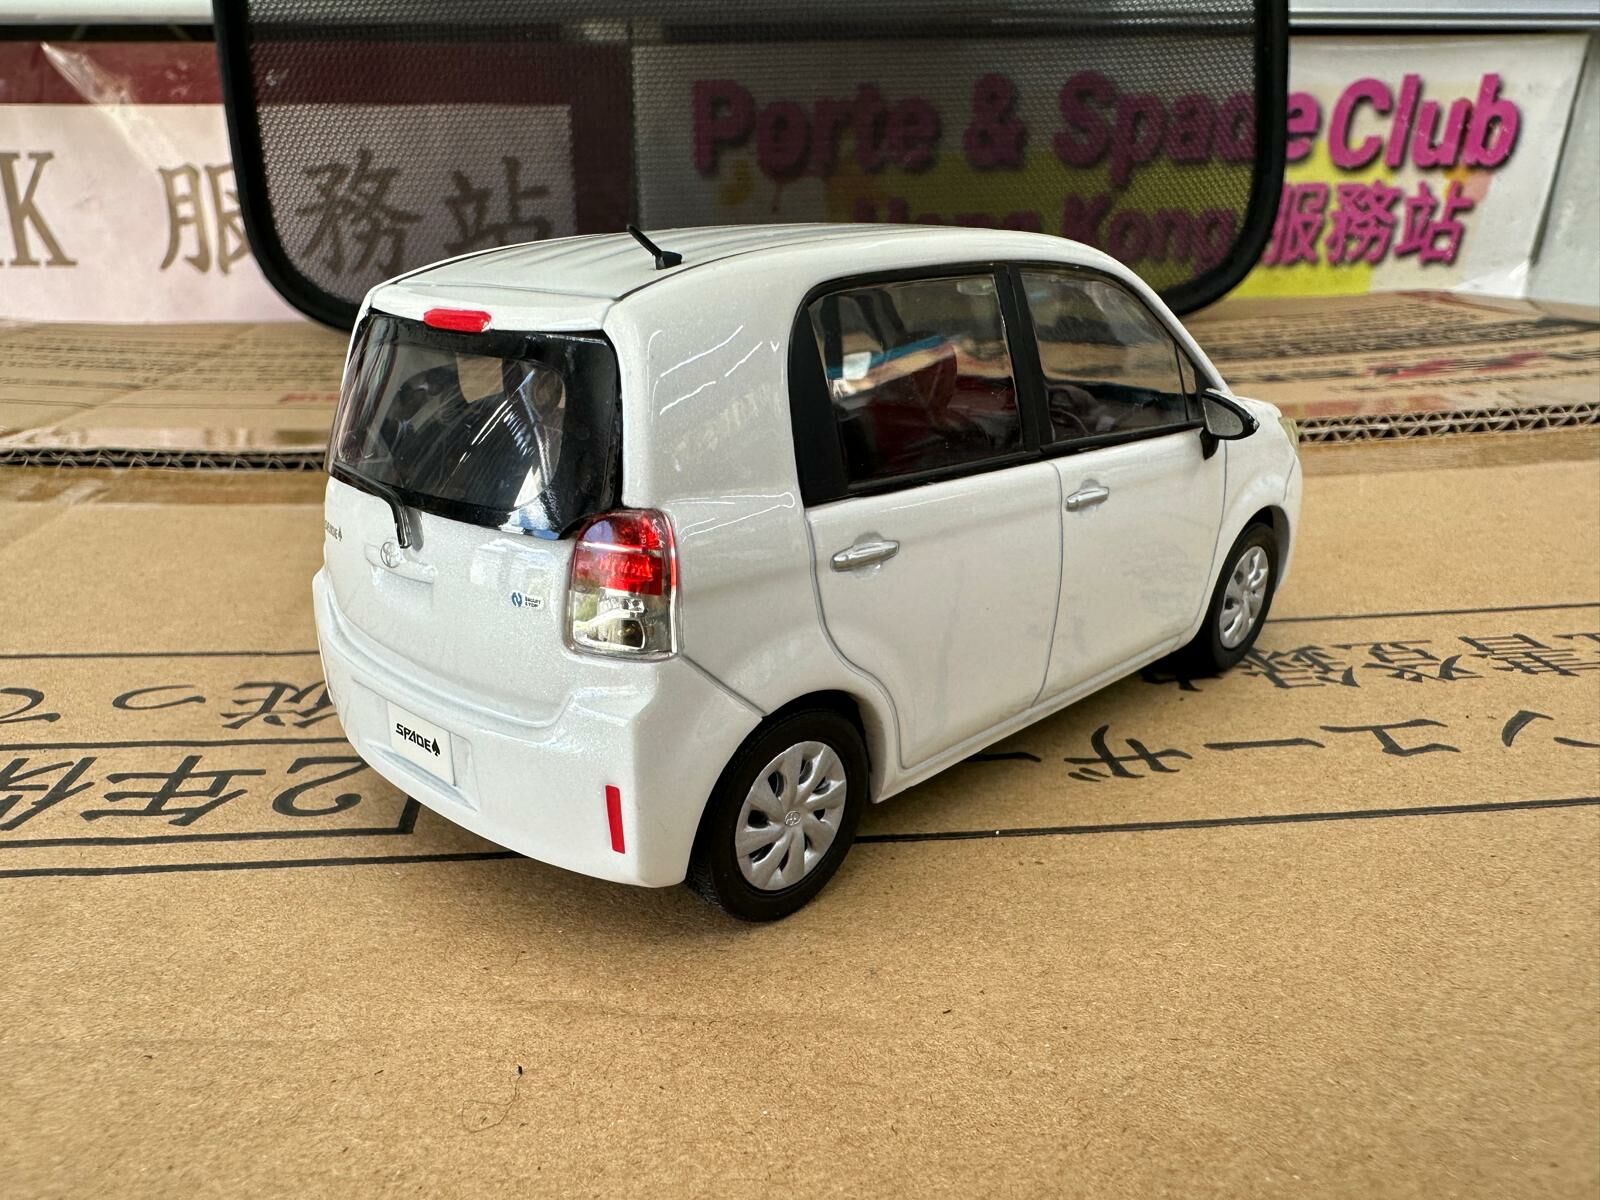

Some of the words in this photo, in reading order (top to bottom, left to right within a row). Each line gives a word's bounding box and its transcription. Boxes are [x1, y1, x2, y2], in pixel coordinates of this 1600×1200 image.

[694, 79, 941, 179] Porte
[963, 71, 1027, 171] &
[1328, 73, 1522, 171] Club
[1262, 180, 1475, 267] 服務站
[395, 722, 432, 754] SPADE
